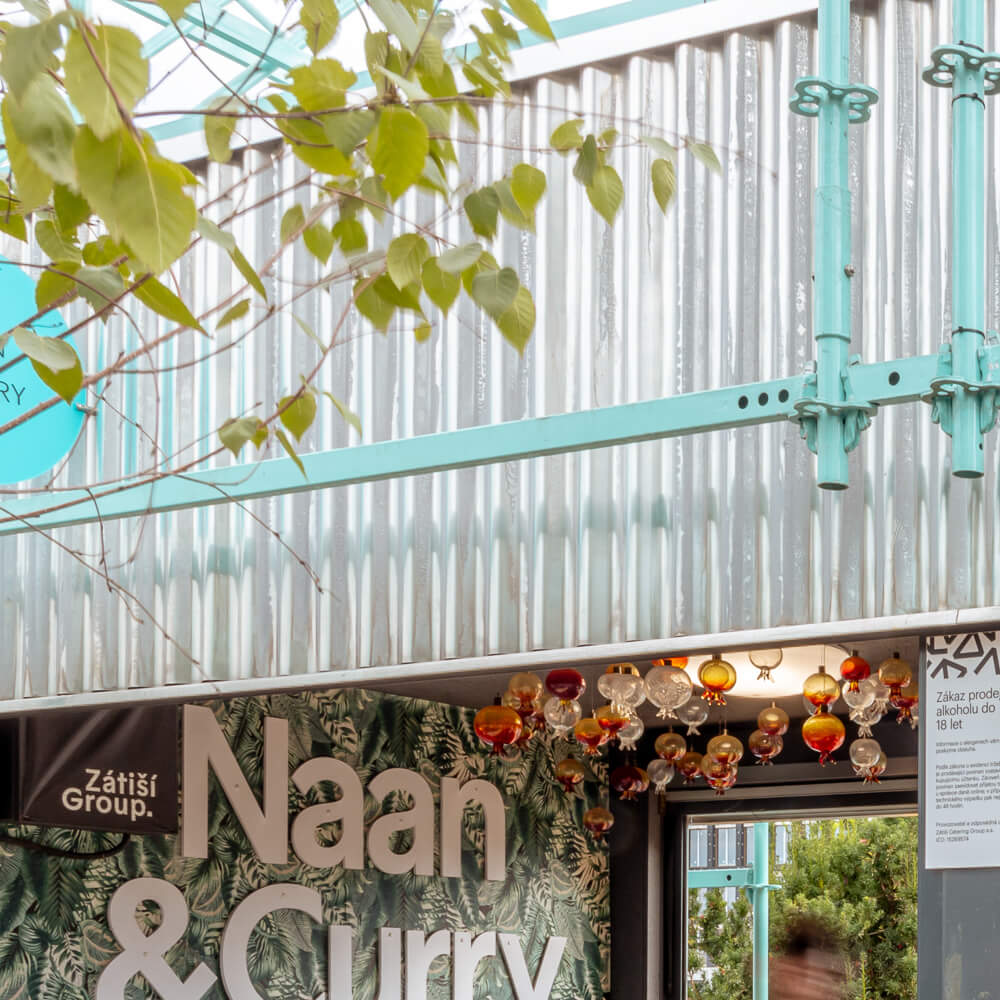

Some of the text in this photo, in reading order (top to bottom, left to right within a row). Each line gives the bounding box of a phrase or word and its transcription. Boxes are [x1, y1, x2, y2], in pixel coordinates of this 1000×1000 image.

[937, 691, 965, 702] Zákaz
[937, 703, 995, 716] alkoholu do
[937, 719, 962, 729] 18 let
[85, 768, 158, 797] Zátiší
[182, 703, 506, 881] Naan
[62, 787, 152, 821] Group.
